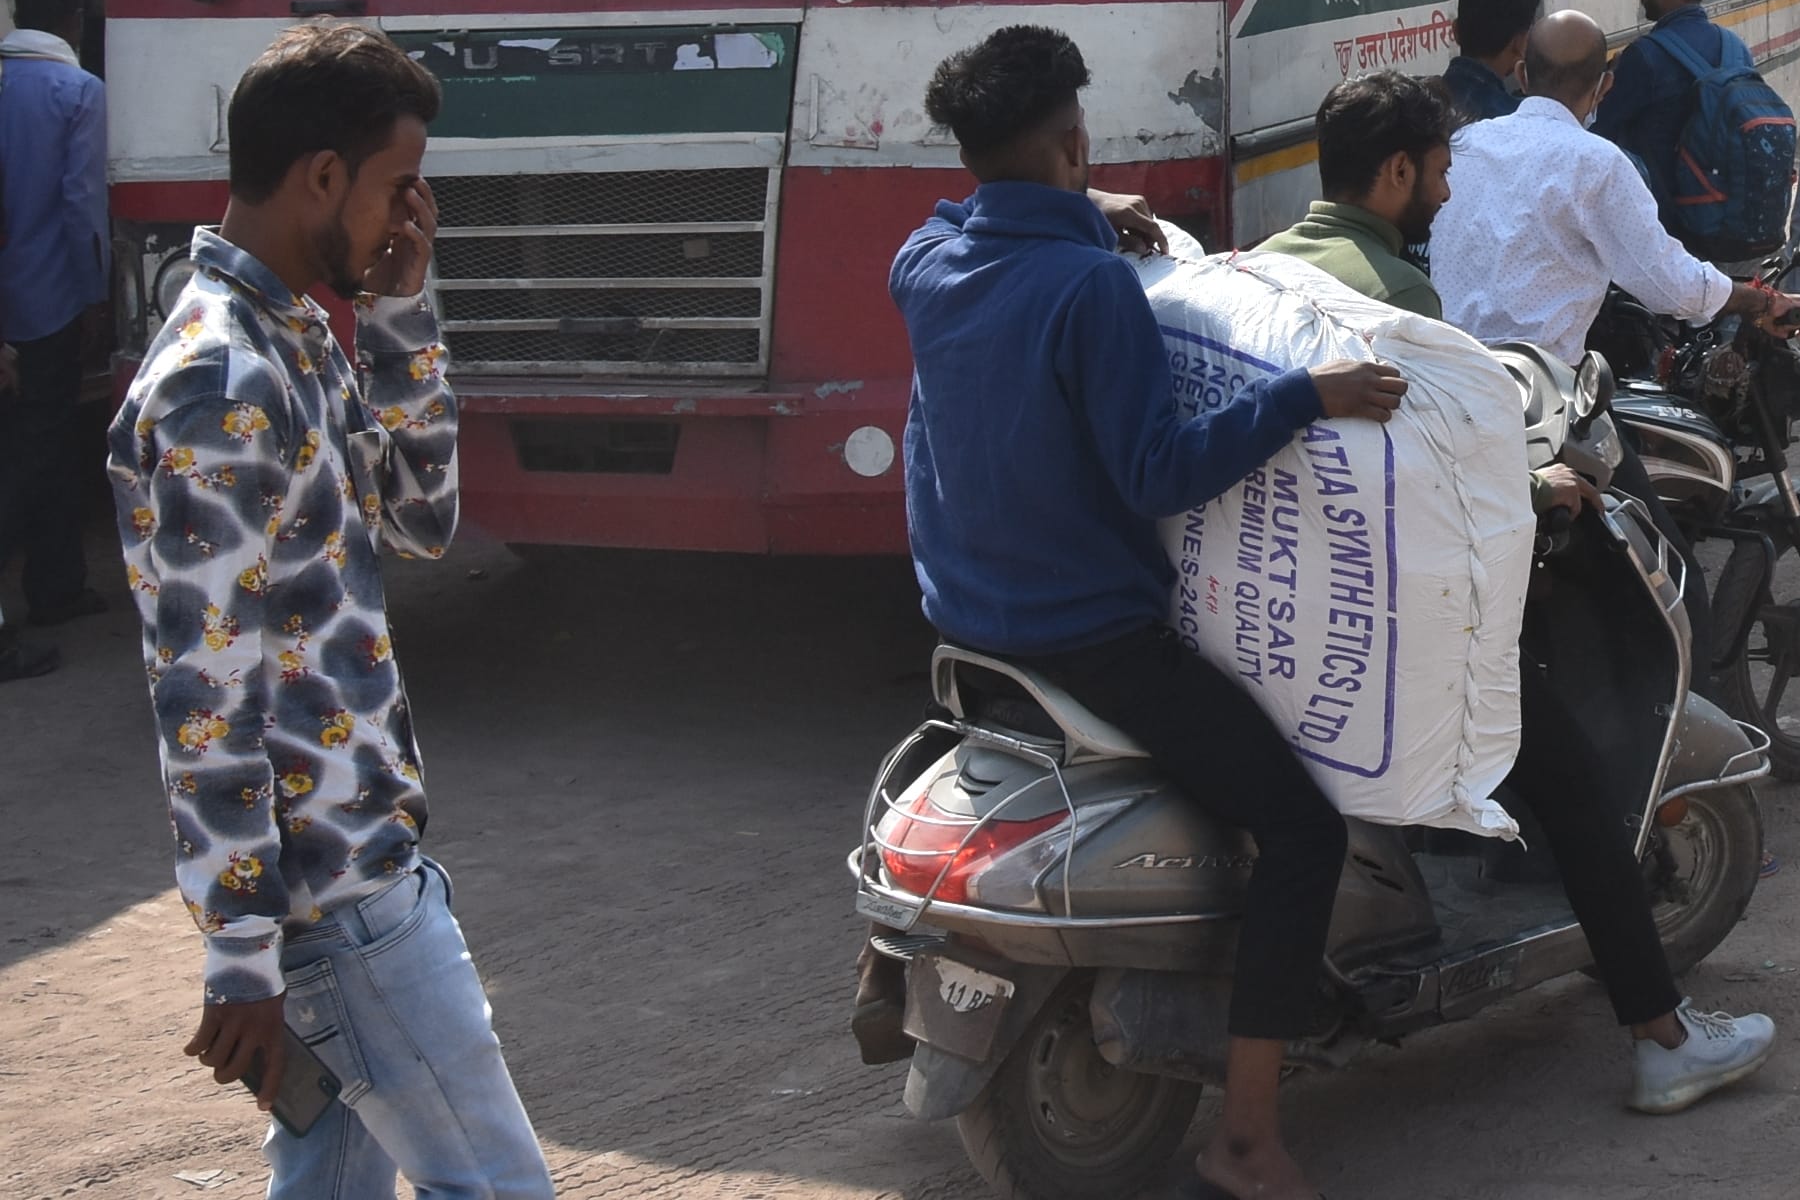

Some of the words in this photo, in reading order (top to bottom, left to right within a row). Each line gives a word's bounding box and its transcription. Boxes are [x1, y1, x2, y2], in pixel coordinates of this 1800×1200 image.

[1355, 32, 1387, 69] उत्तर
[1388, 17, 1418, 65] प्रदेश
[1651, 405, 1697, 419] TVS
[1301, 424, 1358, 496] ATIA
[1237, 465, 1266, 575] REMIUM
[1234, 581, 1263, 687] QUALITY
[1317, 504, 1375, 693] SYNTHETICS
